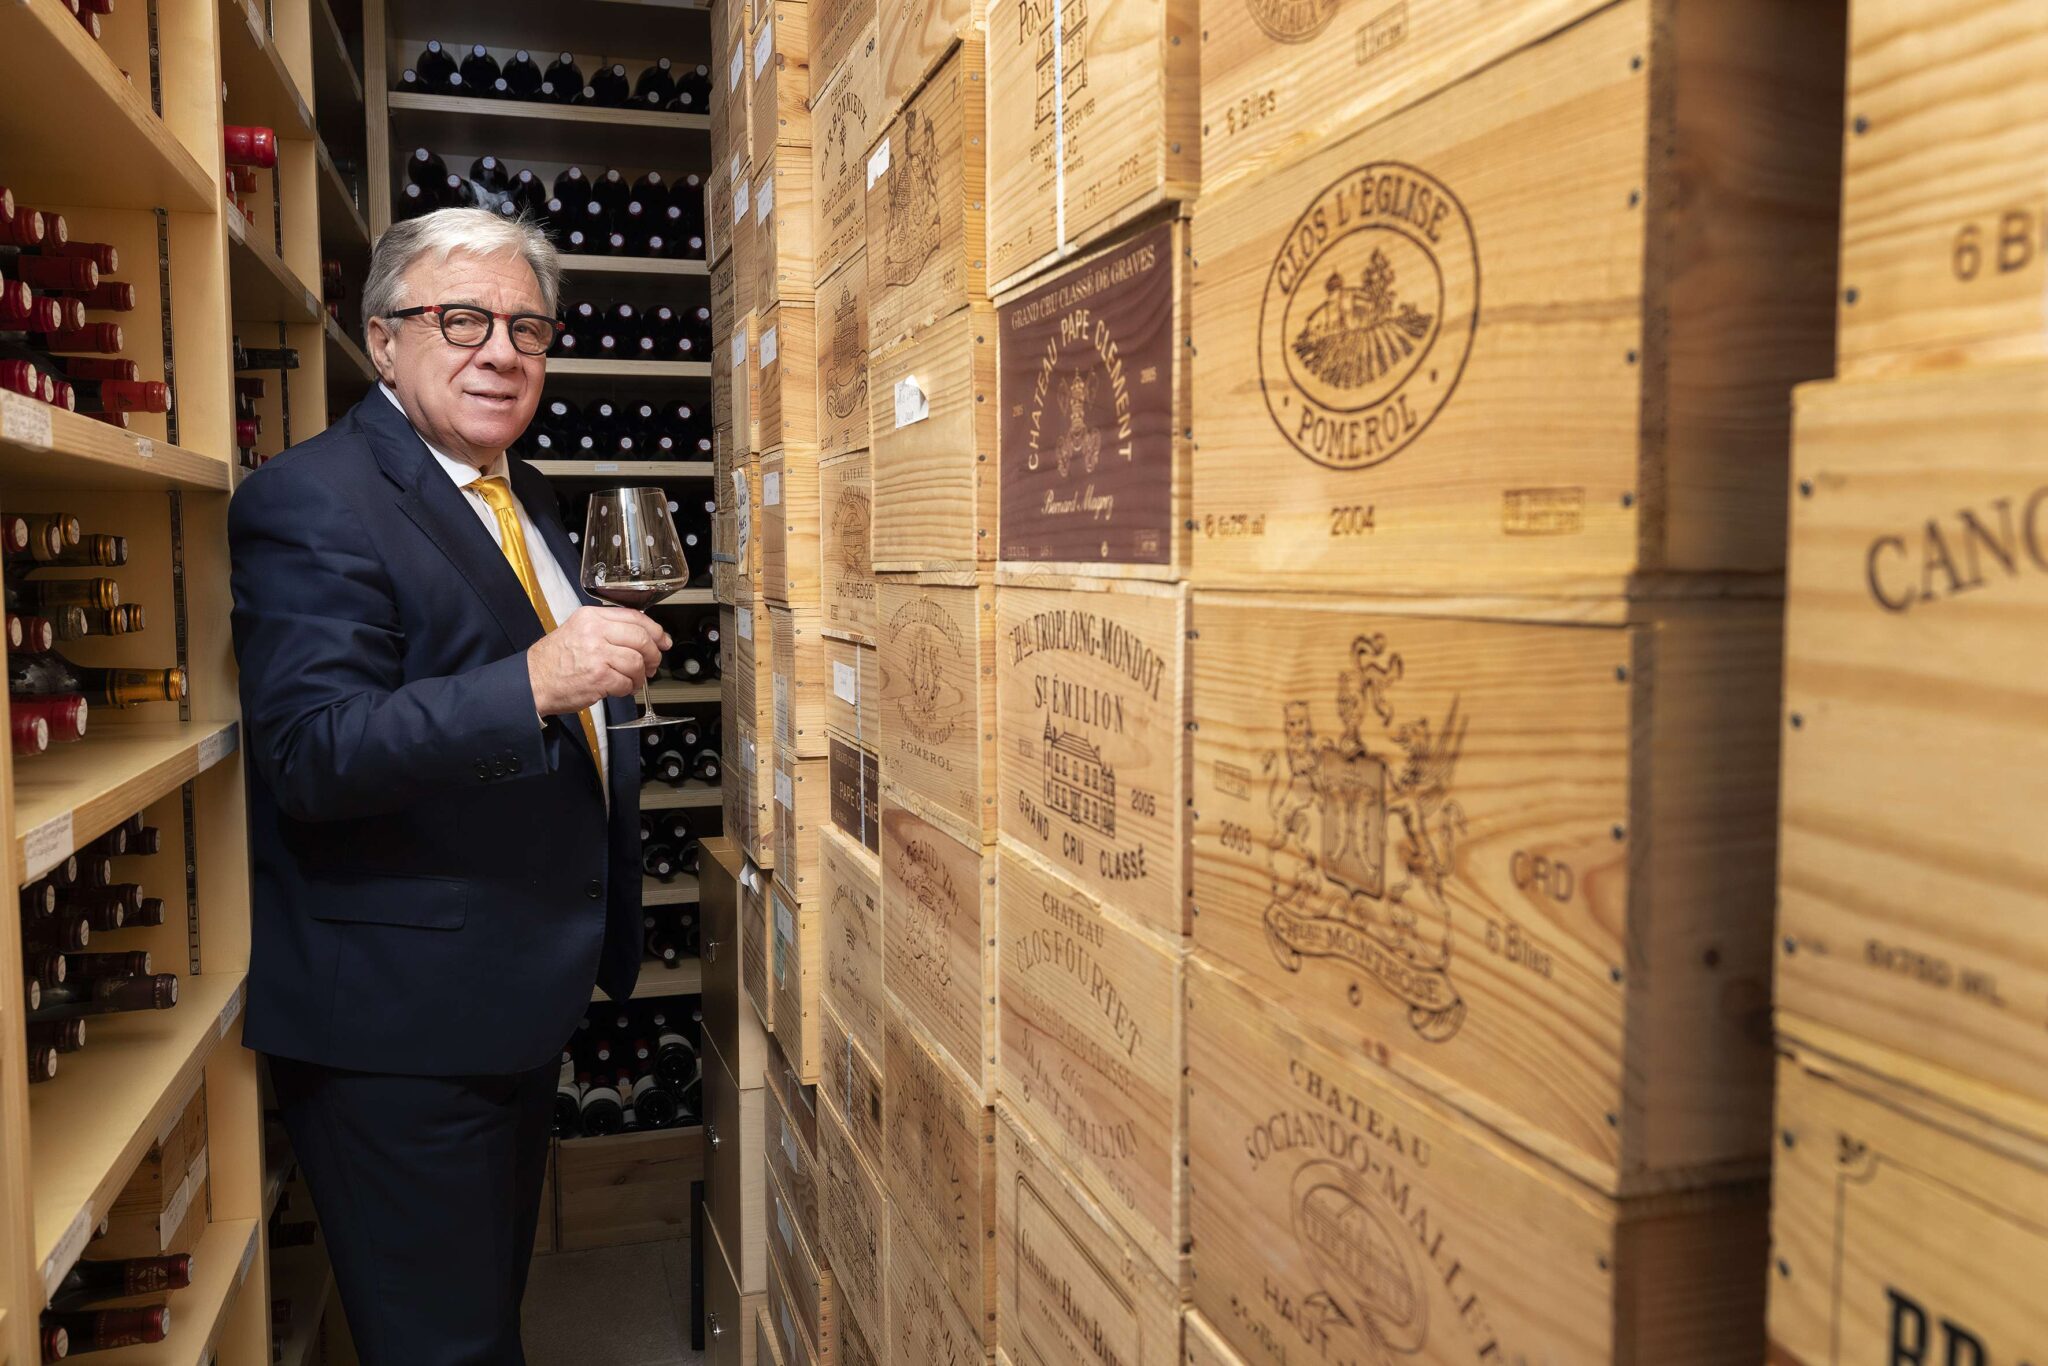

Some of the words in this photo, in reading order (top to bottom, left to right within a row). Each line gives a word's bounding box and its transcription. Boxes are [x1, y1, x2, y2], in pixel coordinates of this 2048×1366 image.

[1276, 208, 1330, 296] CLOS
[1952, 222, 1981, 283] 6
[1997, 207, 2048, 273] B
[1011, 300, 1040, 330] GRAND
[1039, 291, 1059, 319] CRU
[1095, 268, 1111, 292] DE
[1111, 243, 1156, 285] GRAVES
[1028, 336, 1058, 471] CHATEAU
[1061, 309, 1091, 347] PAPE
[1296, 393, 1418, 461] POMEROL
[1329, 504, 1376, 537] 2004
[1034, 609, 1166, 702] TROPLONG-MONDOT
[1052, 673, 1124, 735] ÉMILION
[900, 739, 953, 773] POMEROL
[1018, 789, 1050, 842] GRAND
[1062, 831, 1084, 866] CRU
[1099, 843, 1148, 882] CLASSÉ
[1509, 848, 1575, 903] CRD
[1041, 891, 1105, 950] CHATEAU
[1288, 1058, 1432, 1169] CHATEAU
